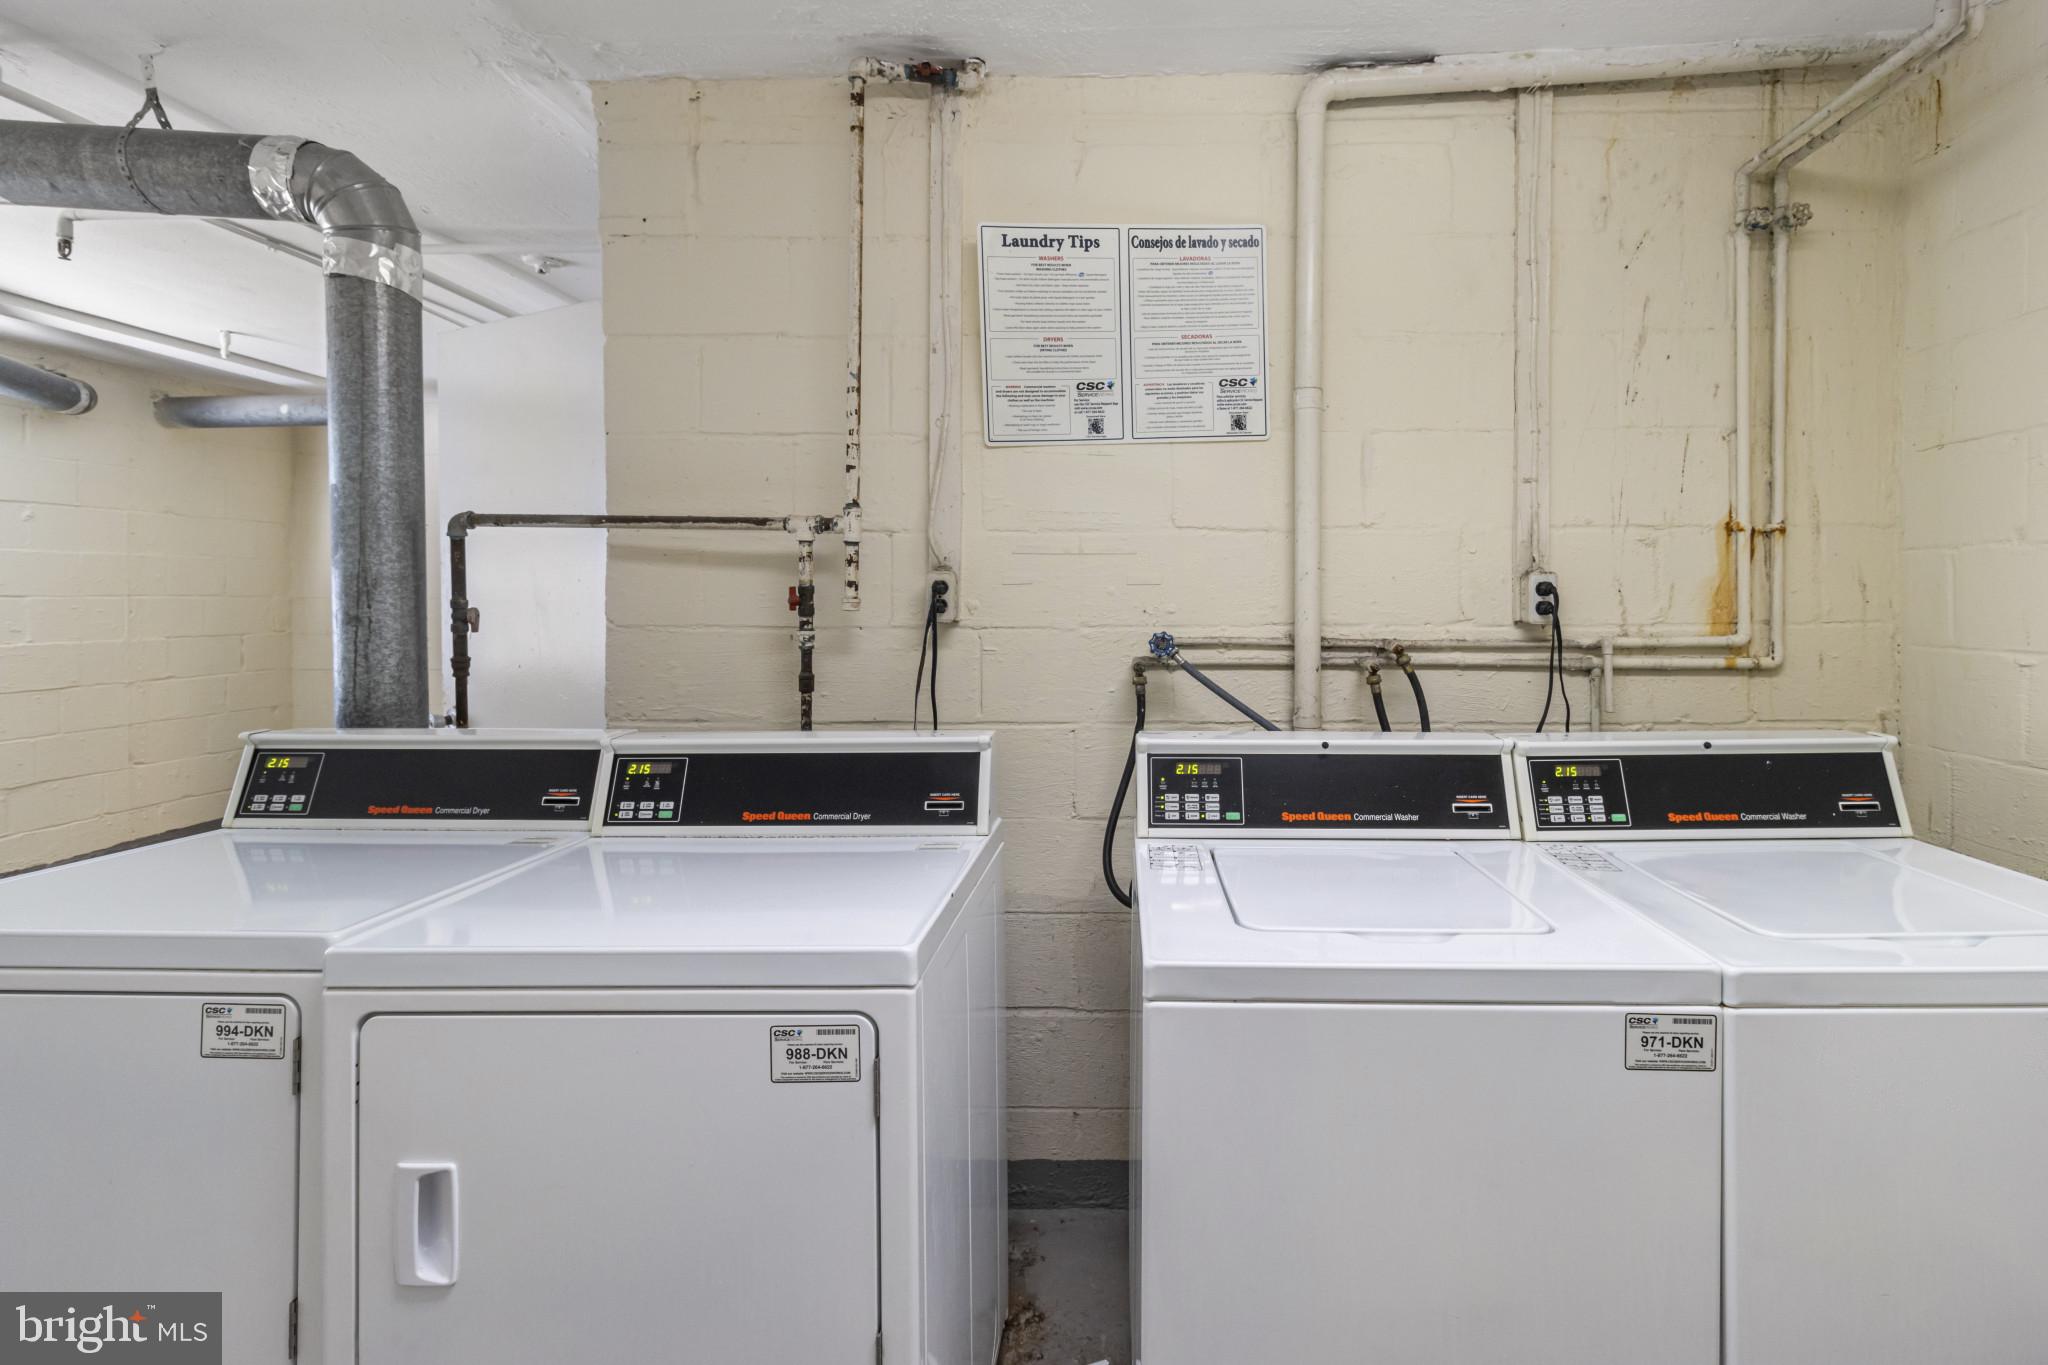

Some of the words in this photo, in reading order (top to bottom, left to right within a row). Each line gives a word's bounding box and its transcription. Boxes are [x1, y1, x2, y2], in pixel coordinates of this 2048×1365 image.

[1001, 234, 1064, 252] Laundry
[1068, 235, 1100, 252] Tips
[1131, 235, 1173, 252] Consejos
[1175, 235, 1186, 248] de
[1188, 235, 1219, 248] lavado
[1221, 238, 1227, 252] y
[1229, 235, 1260, 248] secado
[1076, 382, 1105, 391] CSC
[1219, 378, 1248, 387] CSC
[1176, 764, 1199, 775] 2.15
[1555, 766, 1577, 777] 2.15
[368, 805, 400, 815] Speed
[401, 805, 432, 814] Queen
[435, 806, 472, 814] Commercial
[473, 807, 490, 816] Dryer
[742, 811, 776, 821] Speed
[777, 811, 810, 820] Queen
[813, 812, 852, 820] Commercial
[853, 813, 871, 822] Dryer
[1281, 812, 1316, 822] Speed
[1317, 812, 1351, 821] Queen
[1353, 812, 1393, 821] Commercial
[1394, 813, 1419, 821] Washer
[1667, 812, 1703, 823] Speed
[1704, 812, 1739, 821] Queen
[1740, 813, 1780, 821] Commercial
[1781, 813, 1807, 821] Washer
[216, 1025, 274, 1037] 994-DKN
[773, 1029, 796, 1037] CSC
[1640, 1036, 1704, 1048] 971-DKN
[786, 1047, 848, 1060] 988-DKN
